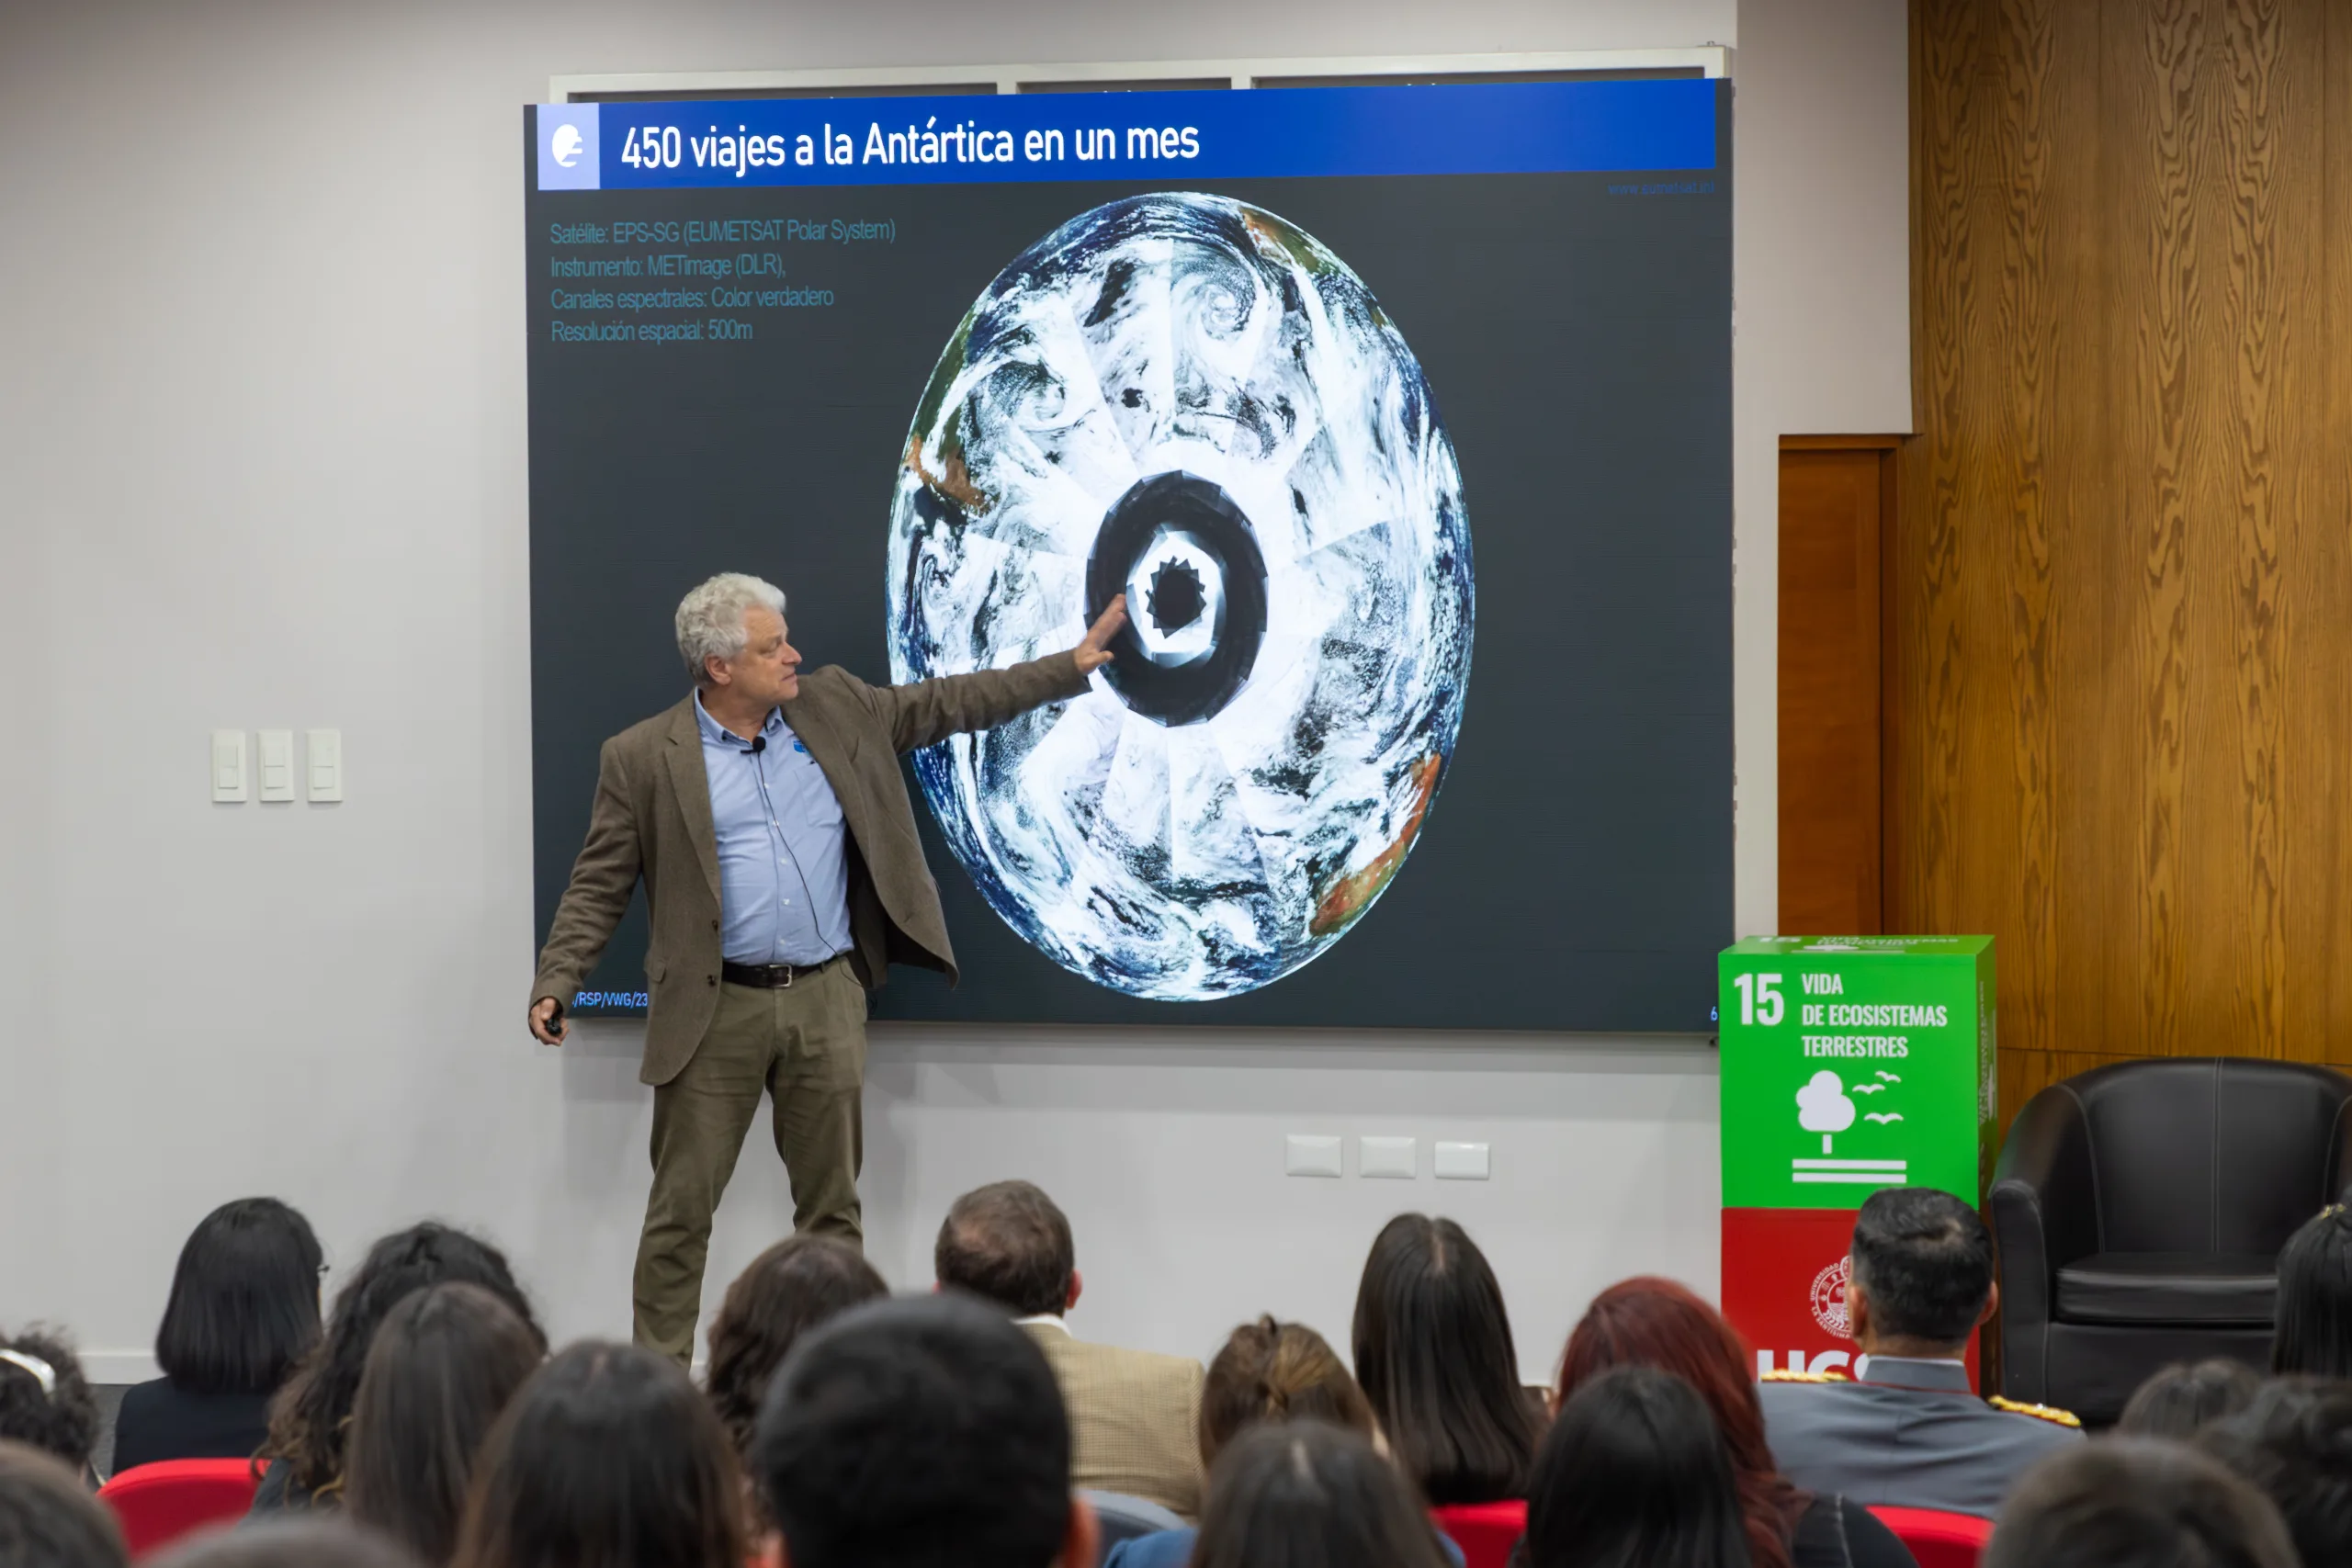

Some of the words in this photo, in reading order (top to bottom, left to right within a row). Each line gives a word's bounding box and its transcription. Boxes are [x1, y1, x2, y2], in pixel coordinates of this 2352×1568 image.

[621, 126, 681, 168] 450
[690, 124, 786, 177] viajes
[795, 134, 814, 166] a
[824, 123, 853, 165] la
[862, 116, 1014, 164] Antártica
[1023, 130, 1064, 162] en
[1075, 127, 1115, 161] un
[1127, 126, 1200, 159] mes
[550, 222, 608, 244] Satélite:
[613, 221, 679, 244] EPS-SG
[684, 220, 782, 246] (EUMETSAT
[787, 220, 828, 241] Polar
[831, 219, 895, 245] System)
[551, 255, 643, 277] Instrumento:
[648, 254, 732, 279] METimage
[735, 253, 786, 279] (DLR),
[551, 288, 614, 310] Canales
[616, 288, 707, 313] espectrales:
[711, 287, 753, 308] Color
[755, 286, 834, 307] verdadero
[552, 320, 635, 342] Resolución
[639, 320, 705, 344] espacial:
[708, 320, 752, 341] 500m
[1801, 973, 1844, 996] VIDA
[571, 991, 648, 1009] /RSP/VWG/23
[1734, 973, 1784, 1026] 15
[1802, 1004, 1825, 1027] DE
[1828, 1004, 1948, 1027] ECOSISTEMAS
[1801, 1035, 1908, 1058] TERRESTRES
[1810, 1262, 1839, 1302] UNIVERSIDAD
